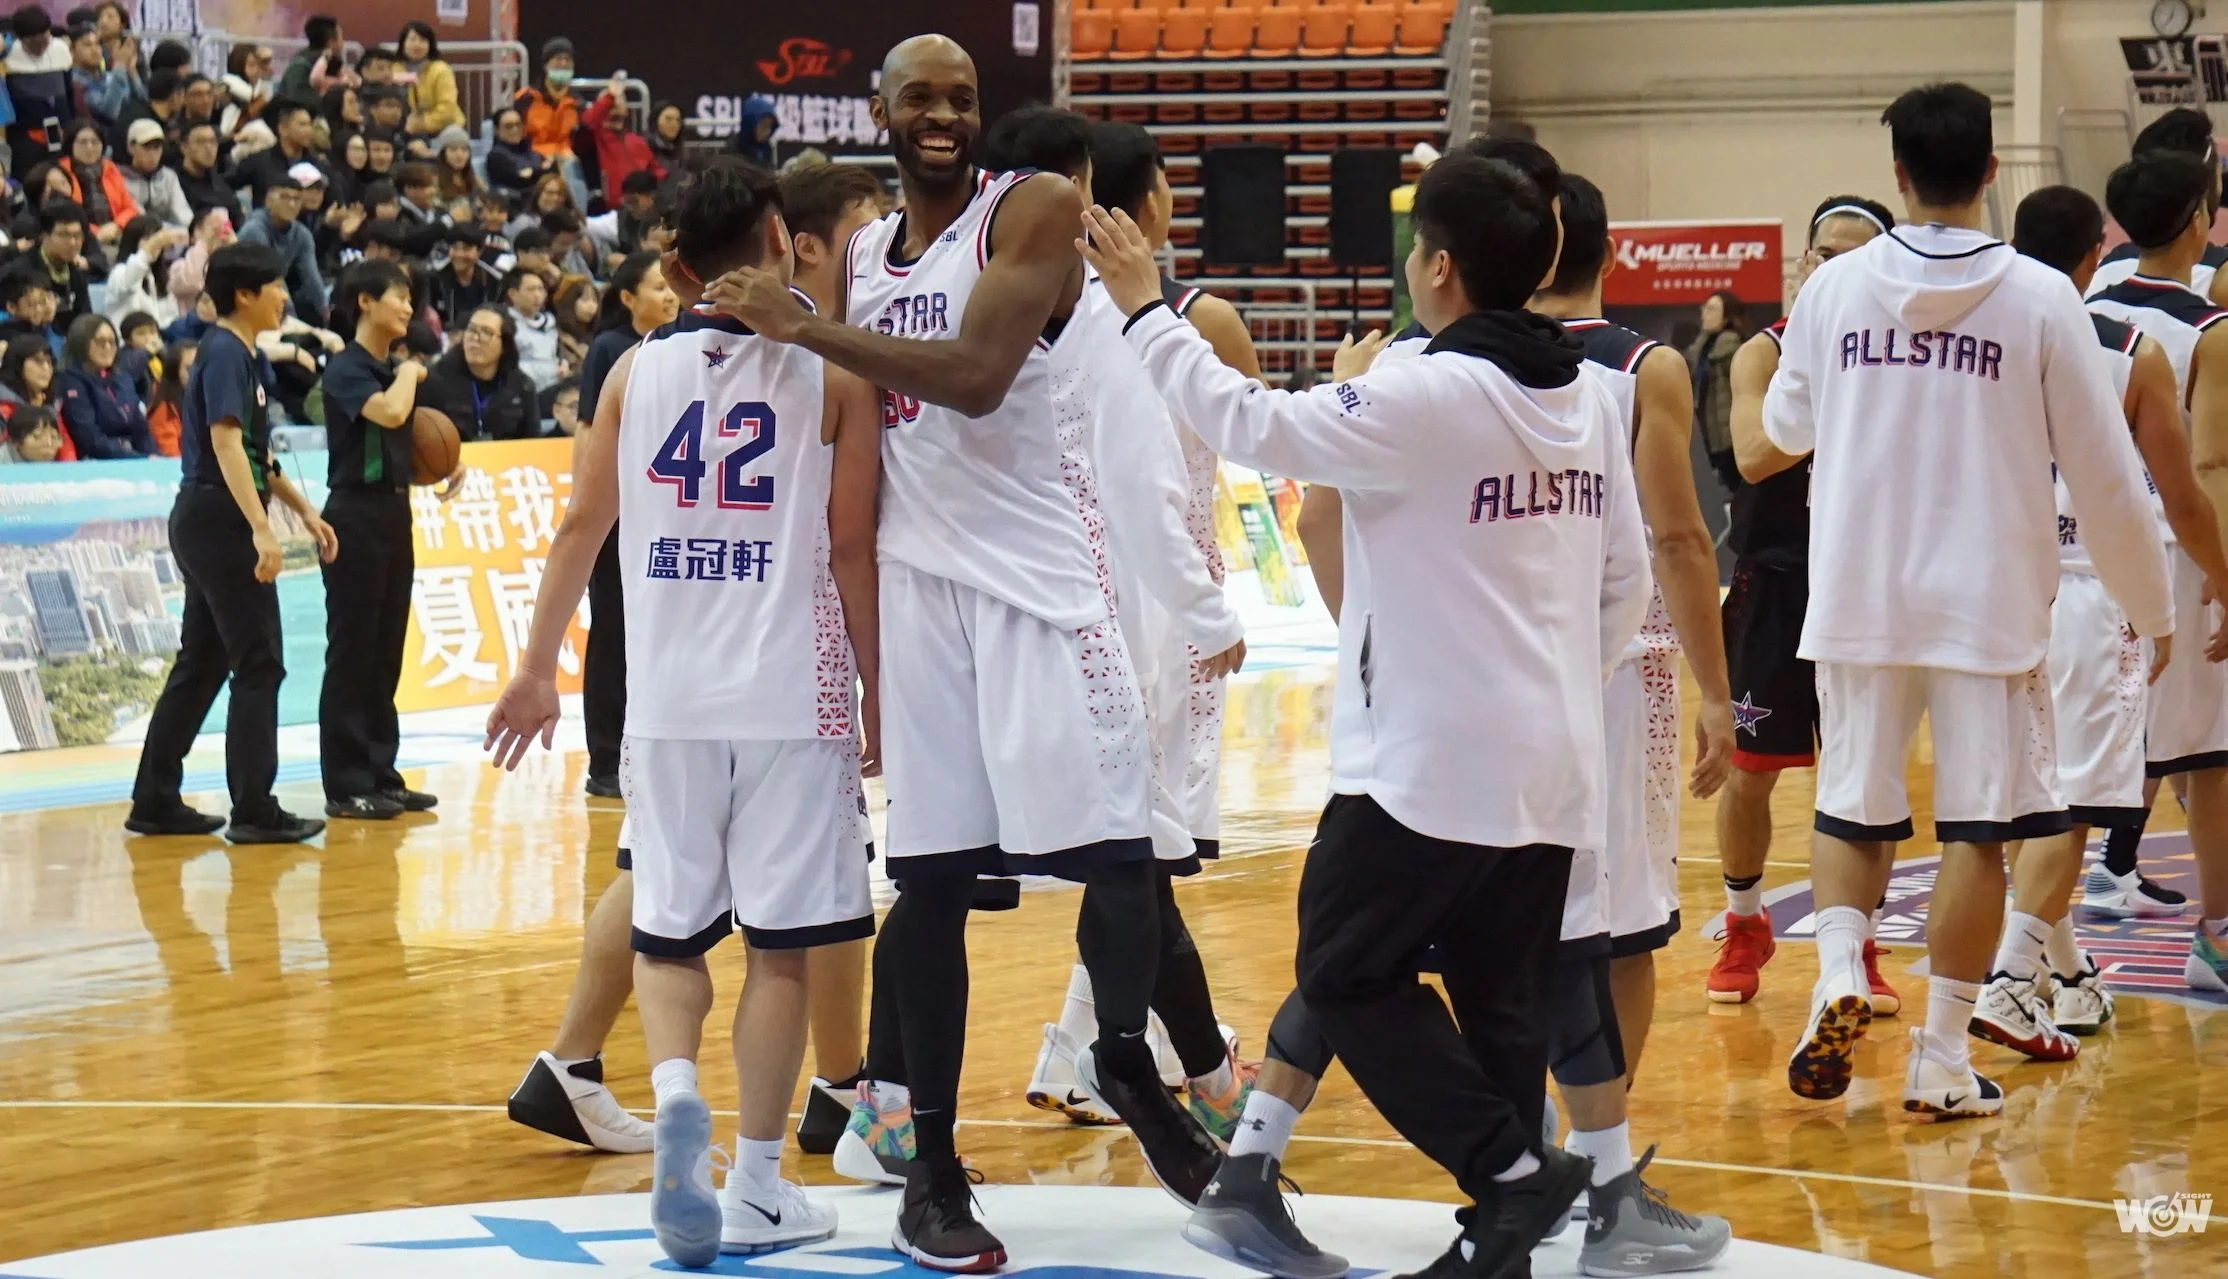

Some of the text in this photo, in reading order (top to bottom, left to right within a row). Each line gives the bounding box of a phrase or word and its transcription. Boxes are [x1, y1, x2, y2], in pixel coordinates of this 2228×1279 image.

[939, 230, 959, 243] SBL
[1635, 241, 1766, 261] MUELLER
[1840, 328, 2003, 382] ALLSTAR
[1336, 382, 1361, 414] SBL
[646, 400, 776, 511] 42
[646, 536, 773, 583] 盧冠軒
